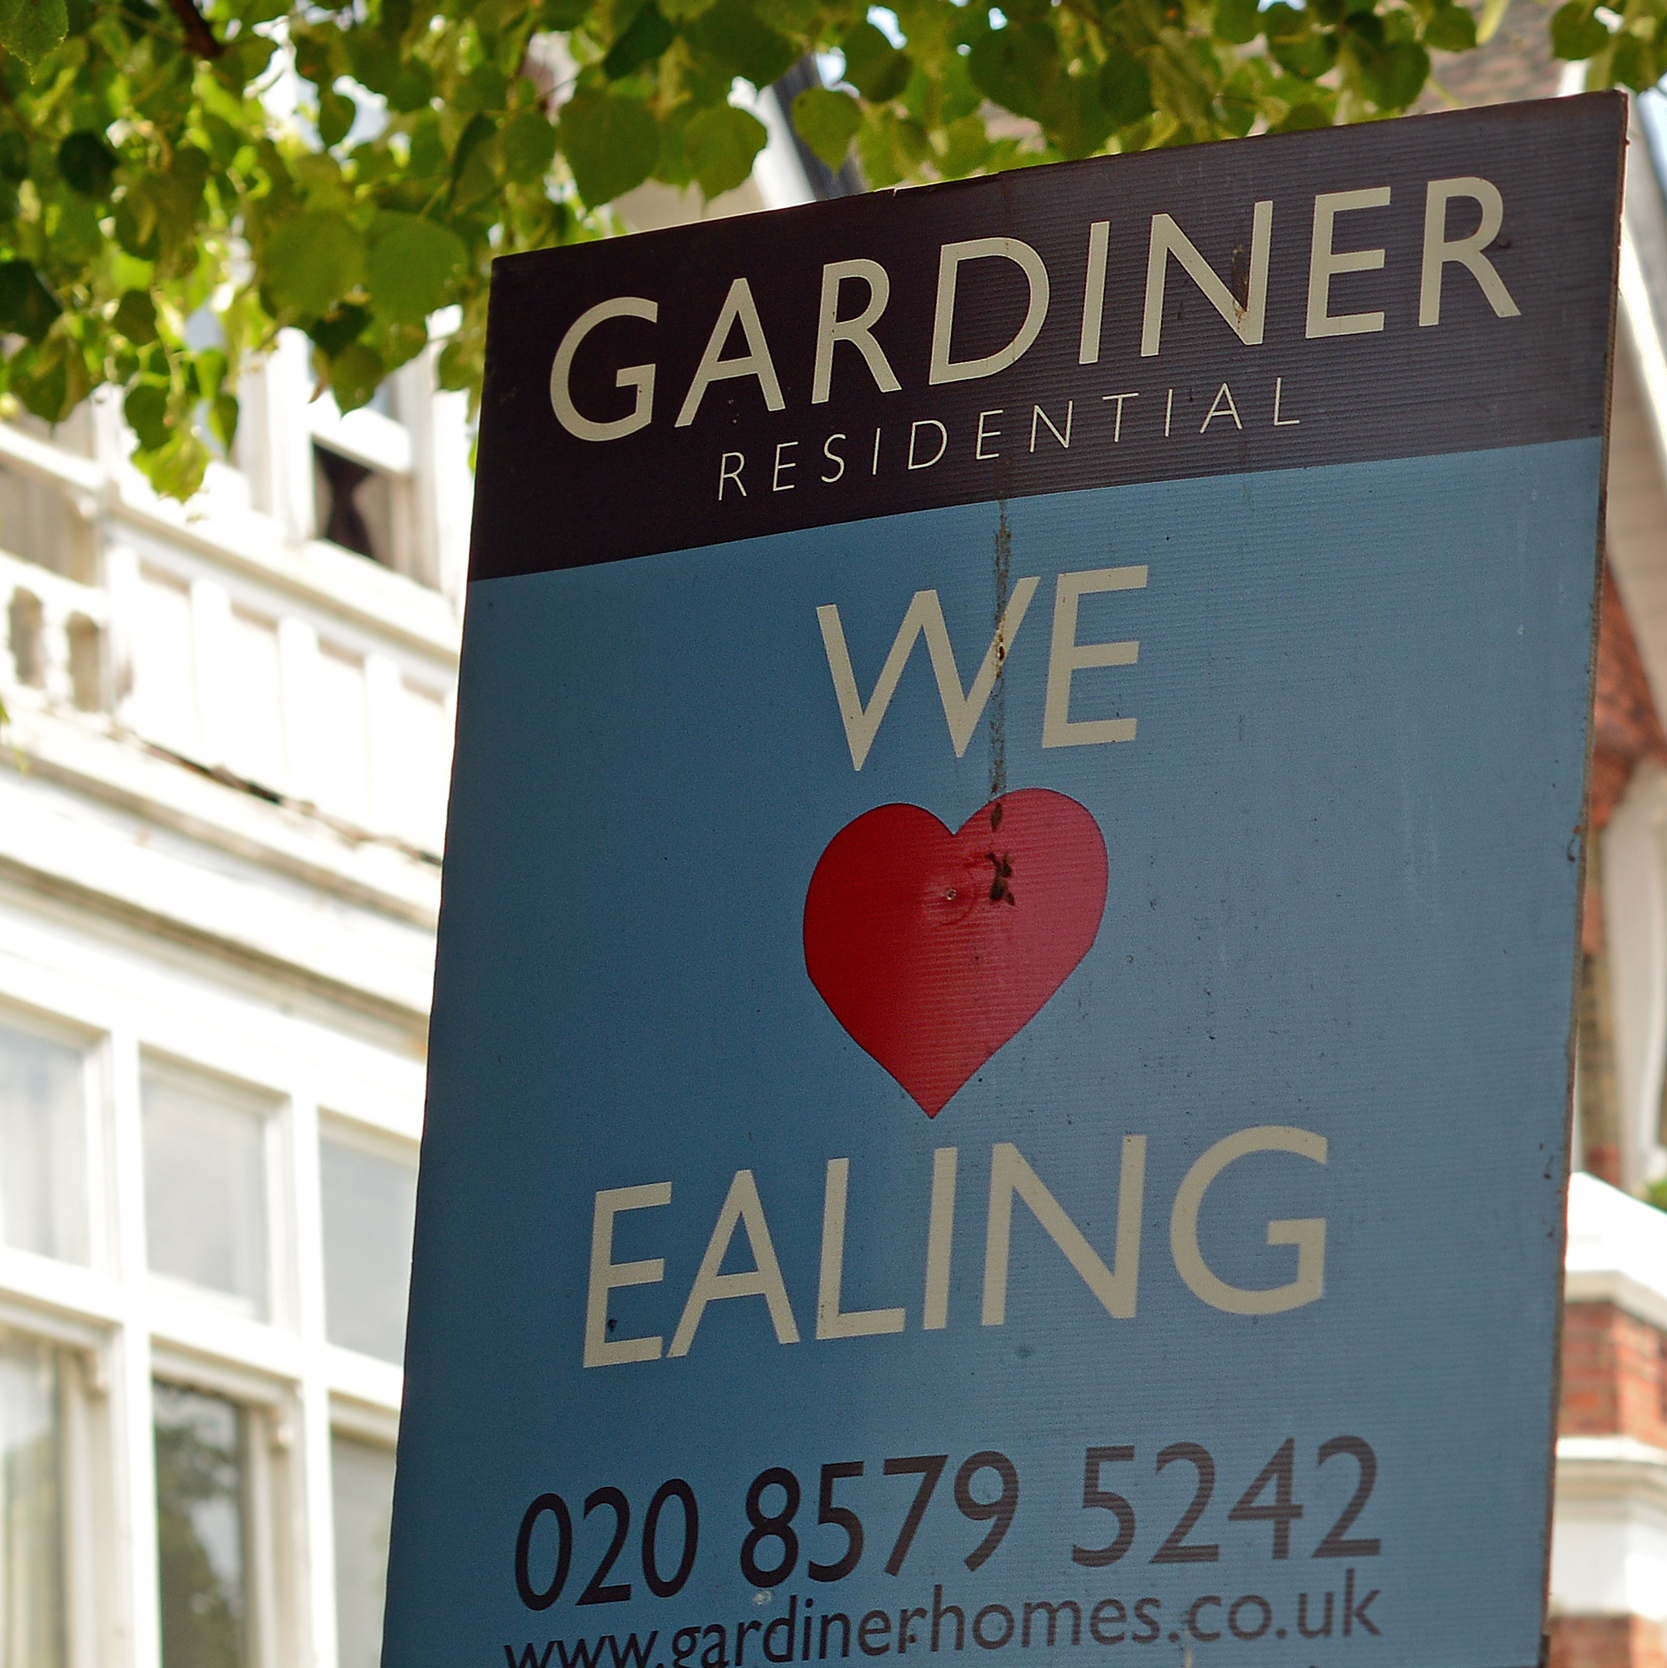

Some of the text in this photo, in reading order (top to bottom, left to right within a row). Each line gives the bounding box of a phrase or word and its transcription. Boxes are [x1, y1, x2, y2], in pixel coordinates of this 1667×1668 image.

[549, 177, 1521, 442] GARDINER
[717, 376, 1301, 502] RESIDENTIAL
[816, 565, 1149, 771] WE
[582, 1125, 1329, 1369] EALING
[514, 1435, 1381, 1611] 020 8579 5242
